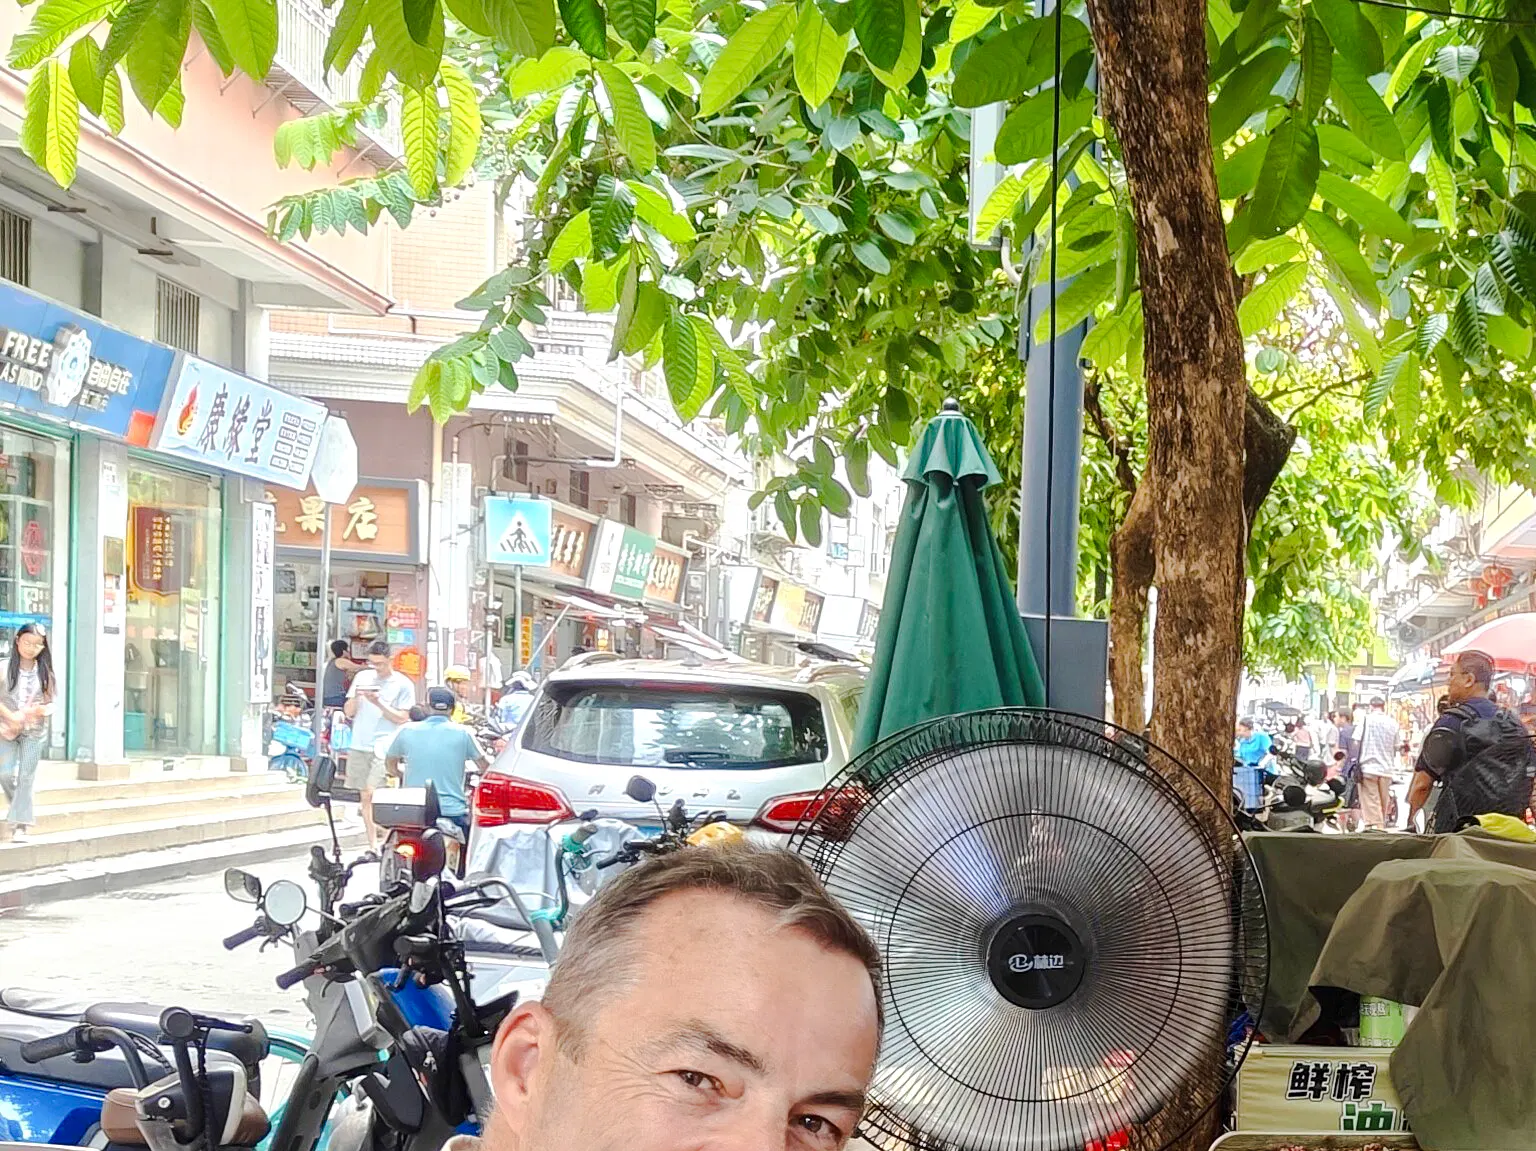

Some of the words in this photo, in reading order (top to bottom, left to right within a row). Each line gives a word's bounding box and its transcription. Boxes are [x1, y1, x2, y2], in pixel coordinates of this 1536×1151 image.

[1, 331, 53, 367] FREE
[1, 362, 21, 383] AS
[17, 367, 44, 391] WIND
[1288, 1062, 1377, 1101] 鲜榨
[1342, 1101, 1411, 1131] 油
